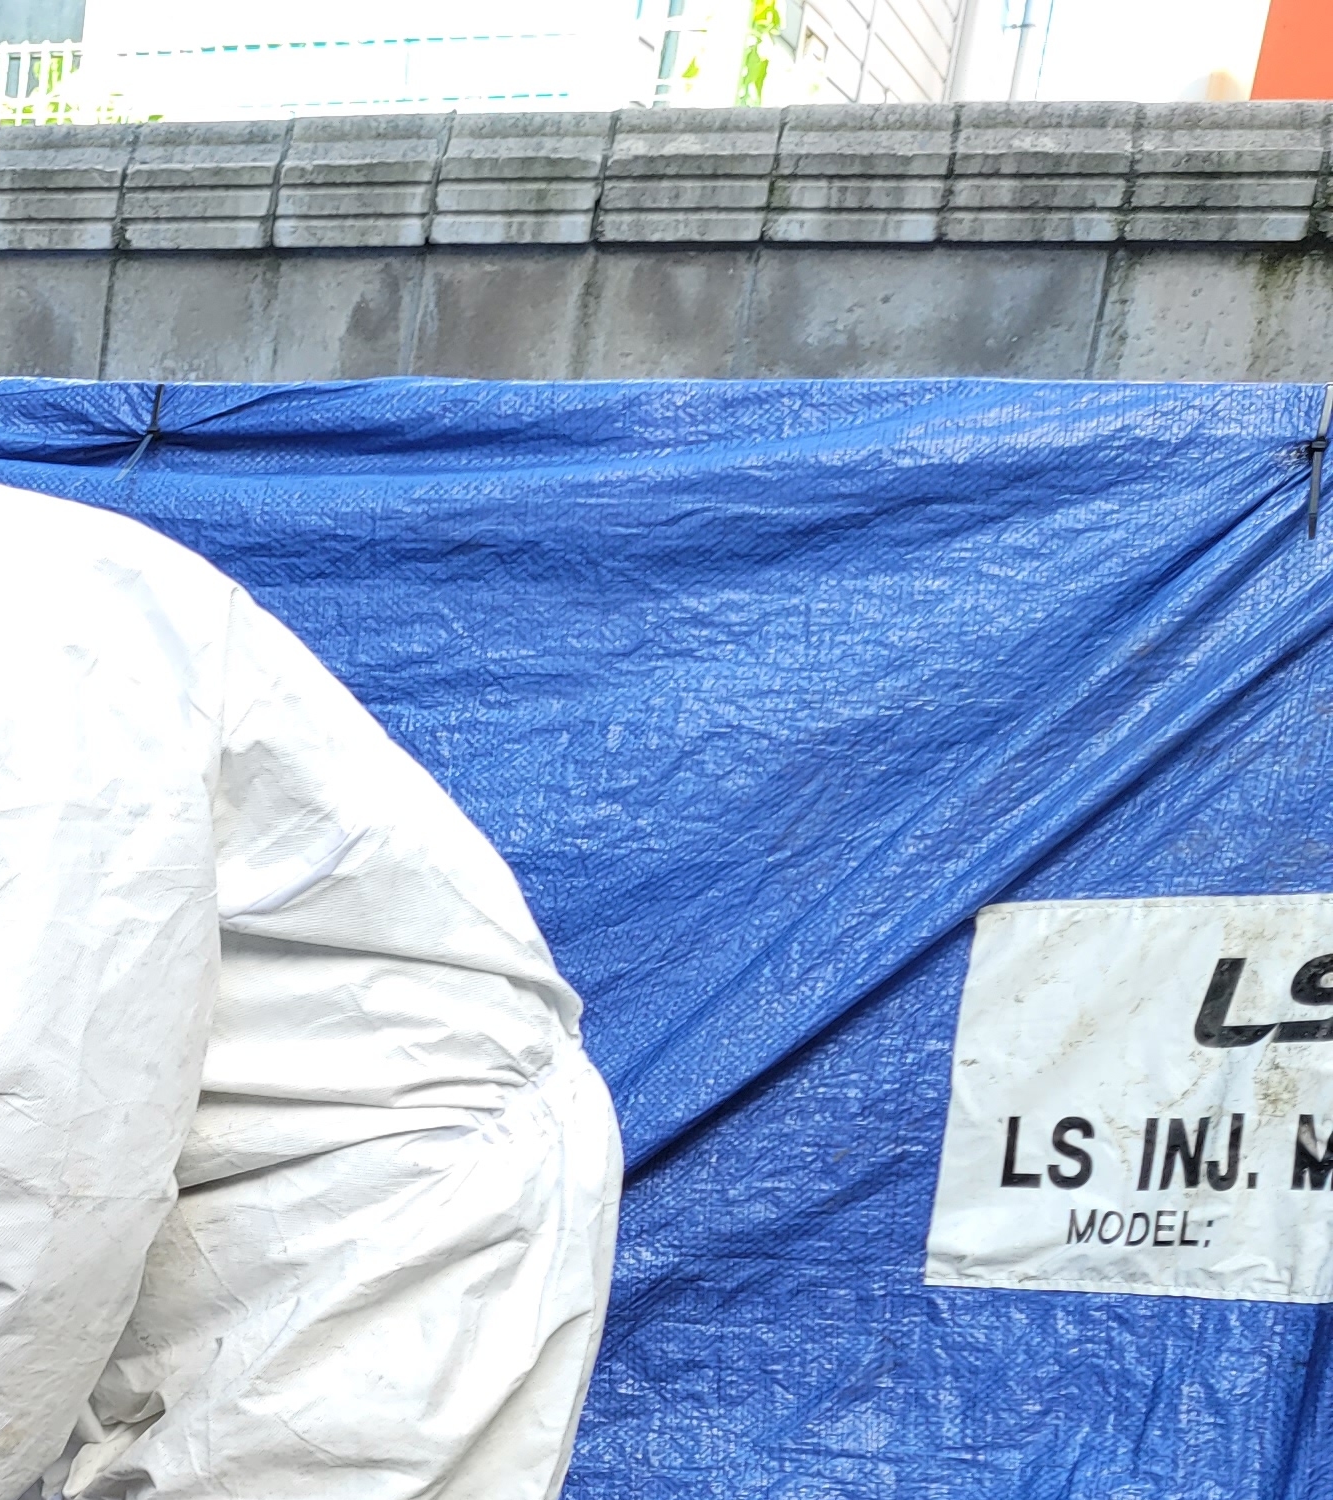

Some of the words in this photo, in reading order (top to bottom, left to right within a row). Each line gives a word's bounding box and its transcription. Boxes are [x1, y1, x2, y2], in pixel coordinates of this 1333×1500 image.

[1000, 1115, 1095, 1190] LS
[1136, 1112, 1259, 1192] INJ.
[1065, 1207, 1214, 1249] MODEL:
